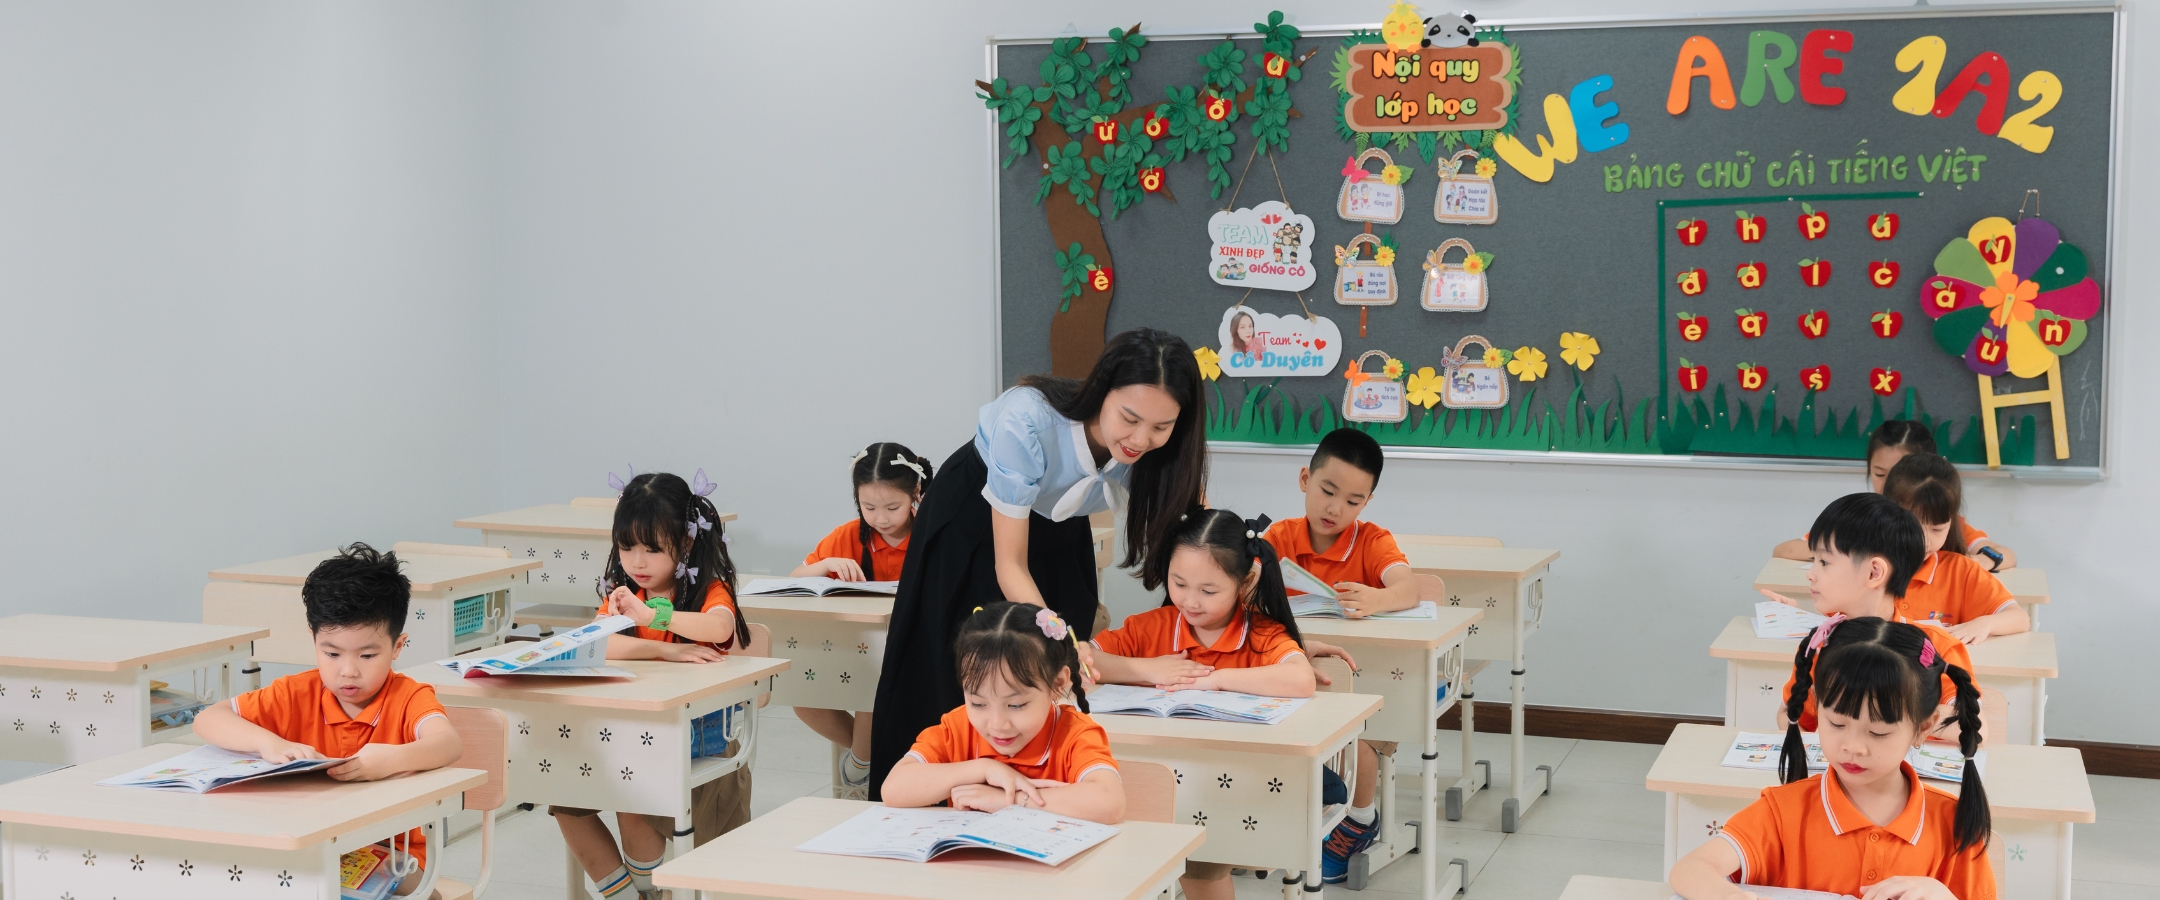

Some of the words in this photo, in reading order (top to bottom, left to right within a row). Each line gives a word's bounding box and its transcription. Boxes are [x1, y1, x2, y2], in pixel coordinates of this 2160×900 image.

[1372, 50, 1421, 83] Nội
[1429, 59, 1480, 83] quy
[1376, 91, 1419, 123] lớp
[1427, 92, 1477, 121] học
[1493, 74, 1630, 183] WE
[1666, 29, 1854, 115] ARE
[1892, 35, 2063, 153] 1A2
[1099, 122, 1114, 141] ư
[1604, 153, 1684, 192] BẢNG
[1696, 150, 1756, 188] CHỮ
[1826, 138, 1908, 184] TIẾNG
[1917, 146, 1988, 190] VIỆT
[1144, 172, 1159, 191] ơ
[1218, 224, 1269, 245] TEAM
[1688, 226, 1699, 243] r
[1742, 219, 1759, 240] h
[1806, 216, 1826, 239] p
[1219, 246, 1244, 256] XINH
[1246, 248, 1265, 260] ĐẸP
[1989, 239, 2005, 262] y
[1094, 270, 1108, 290] ê
[1249, 262, 1285, 274] GIỐNG
[1288, 266, 1305, 277] CÔ
[1741, 265, 1760, 287] â
[1874, 268, 1892, 285] c
[1936, 290, 1956, 308] a
[1684, 324, 1702, 340] e
[1742, 315, 1761, 336] q
[1806, 318, 1823, 336] v
[1882, 314, 1892, 336] t
[2045, 324, 2063, 342] n
[1258, 332, 1292, 346] Team
[1230, 351, 1255, 368] Cô
[1261, 350, 1324, 371] Duyên
[1980, 342, 2000, 362] u
[1690, 369, 1697, 389] i
[1742, 368, 1762, 389] b
[1809, 373, 1823, 390] s
[1874, 374, 1894, 392] x
